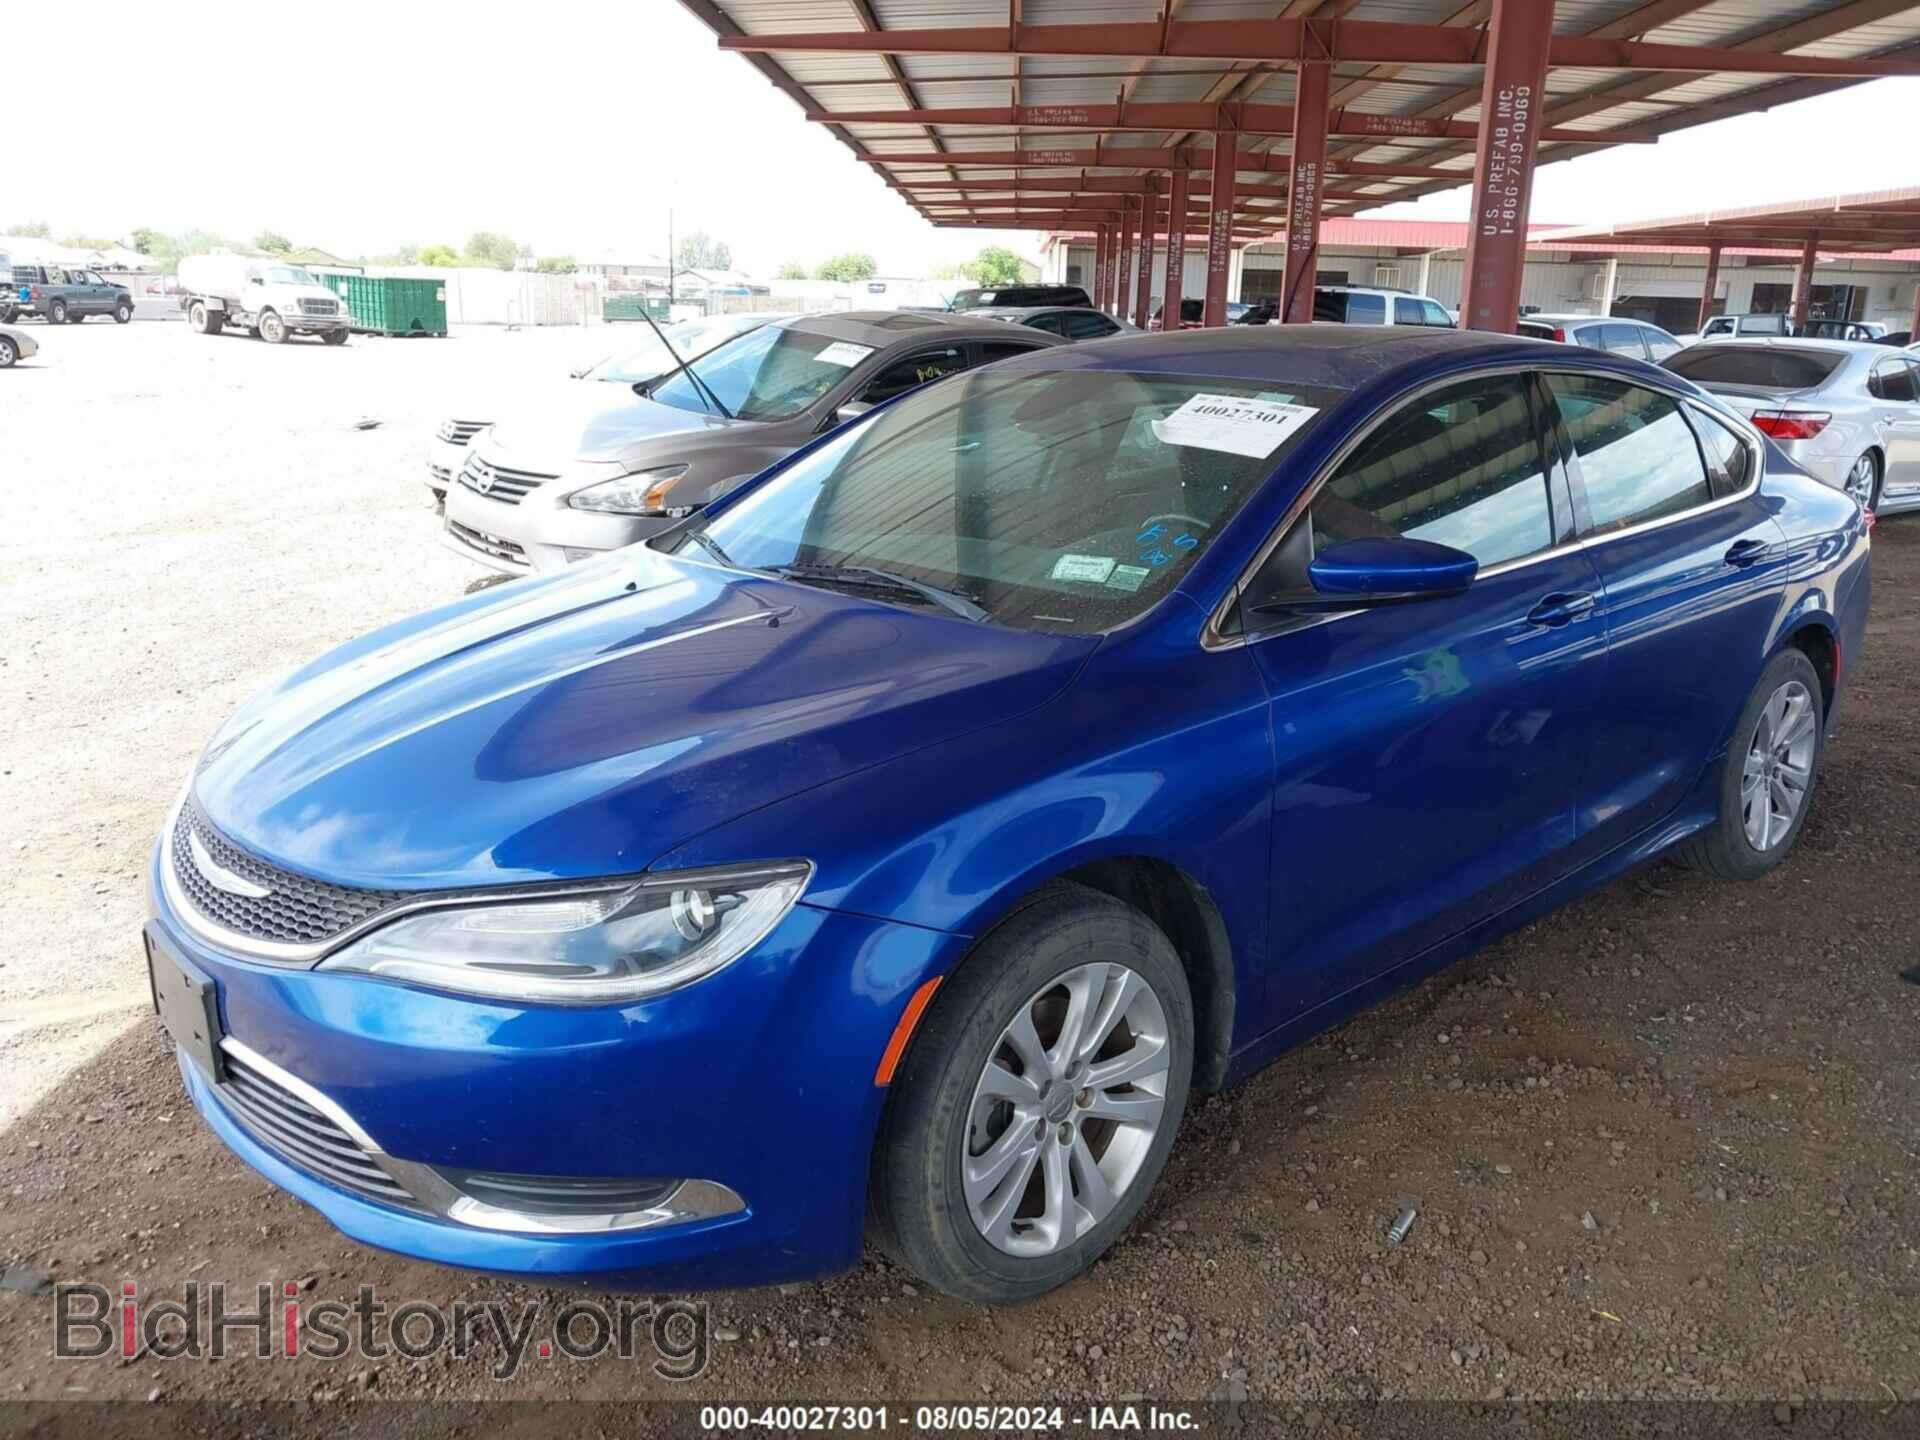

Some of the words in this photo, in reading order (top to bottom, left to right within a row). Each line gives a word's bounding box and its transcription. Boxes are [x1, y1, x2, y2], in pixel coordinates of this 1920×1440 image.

[1497, 84, 1515, 117] INC.
[1488, 127, 1509, 193] PREFAB
[1483, 204, 1501, 235] U.S.
[1192, 405, 1288, 424] 40027301
